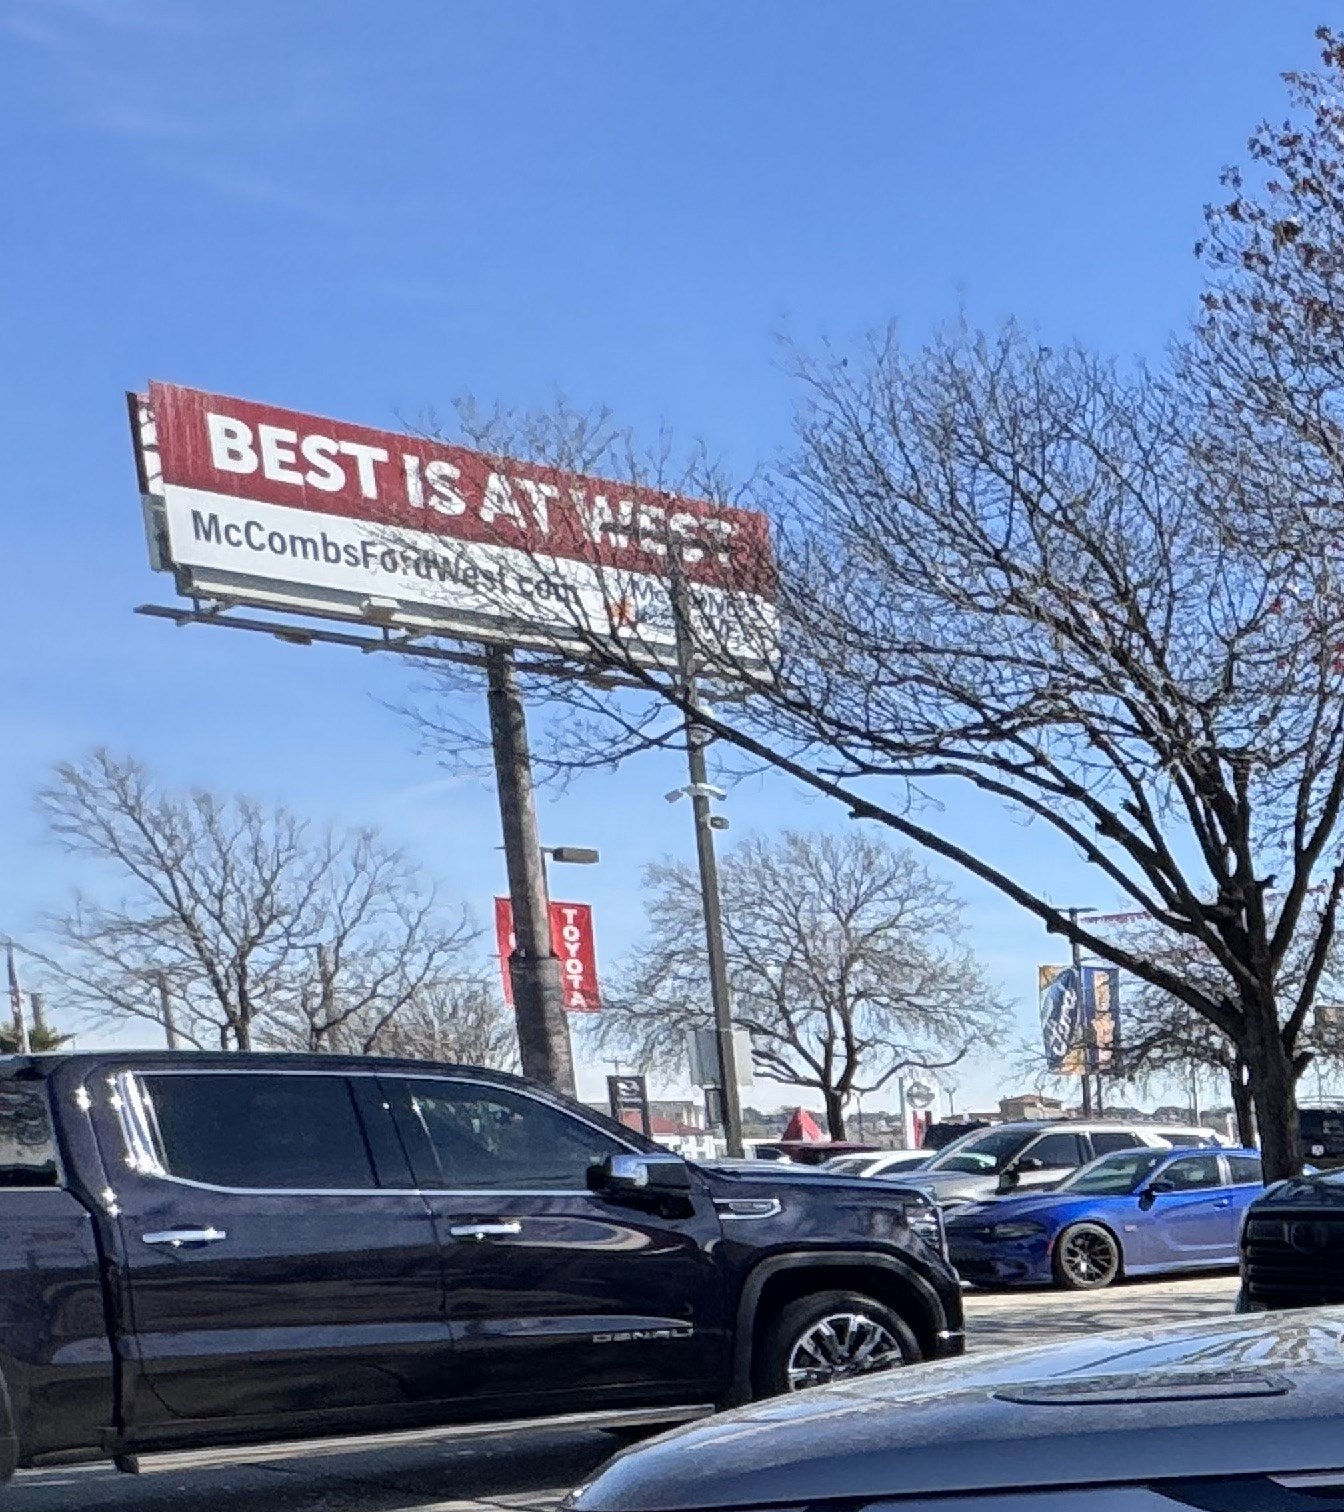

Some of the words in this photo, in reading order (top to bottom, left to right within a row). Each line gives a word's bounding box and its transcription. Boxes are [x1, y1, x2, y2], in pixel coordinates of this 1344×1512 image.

[206, 411, 389, 500] BEST
[402, 454, 467, 516] IS
[479, 472, 560, 535] AT
[562, 907, 589, 1008] TOYOTA
[592, 1328, 694, 1344] DENALI
